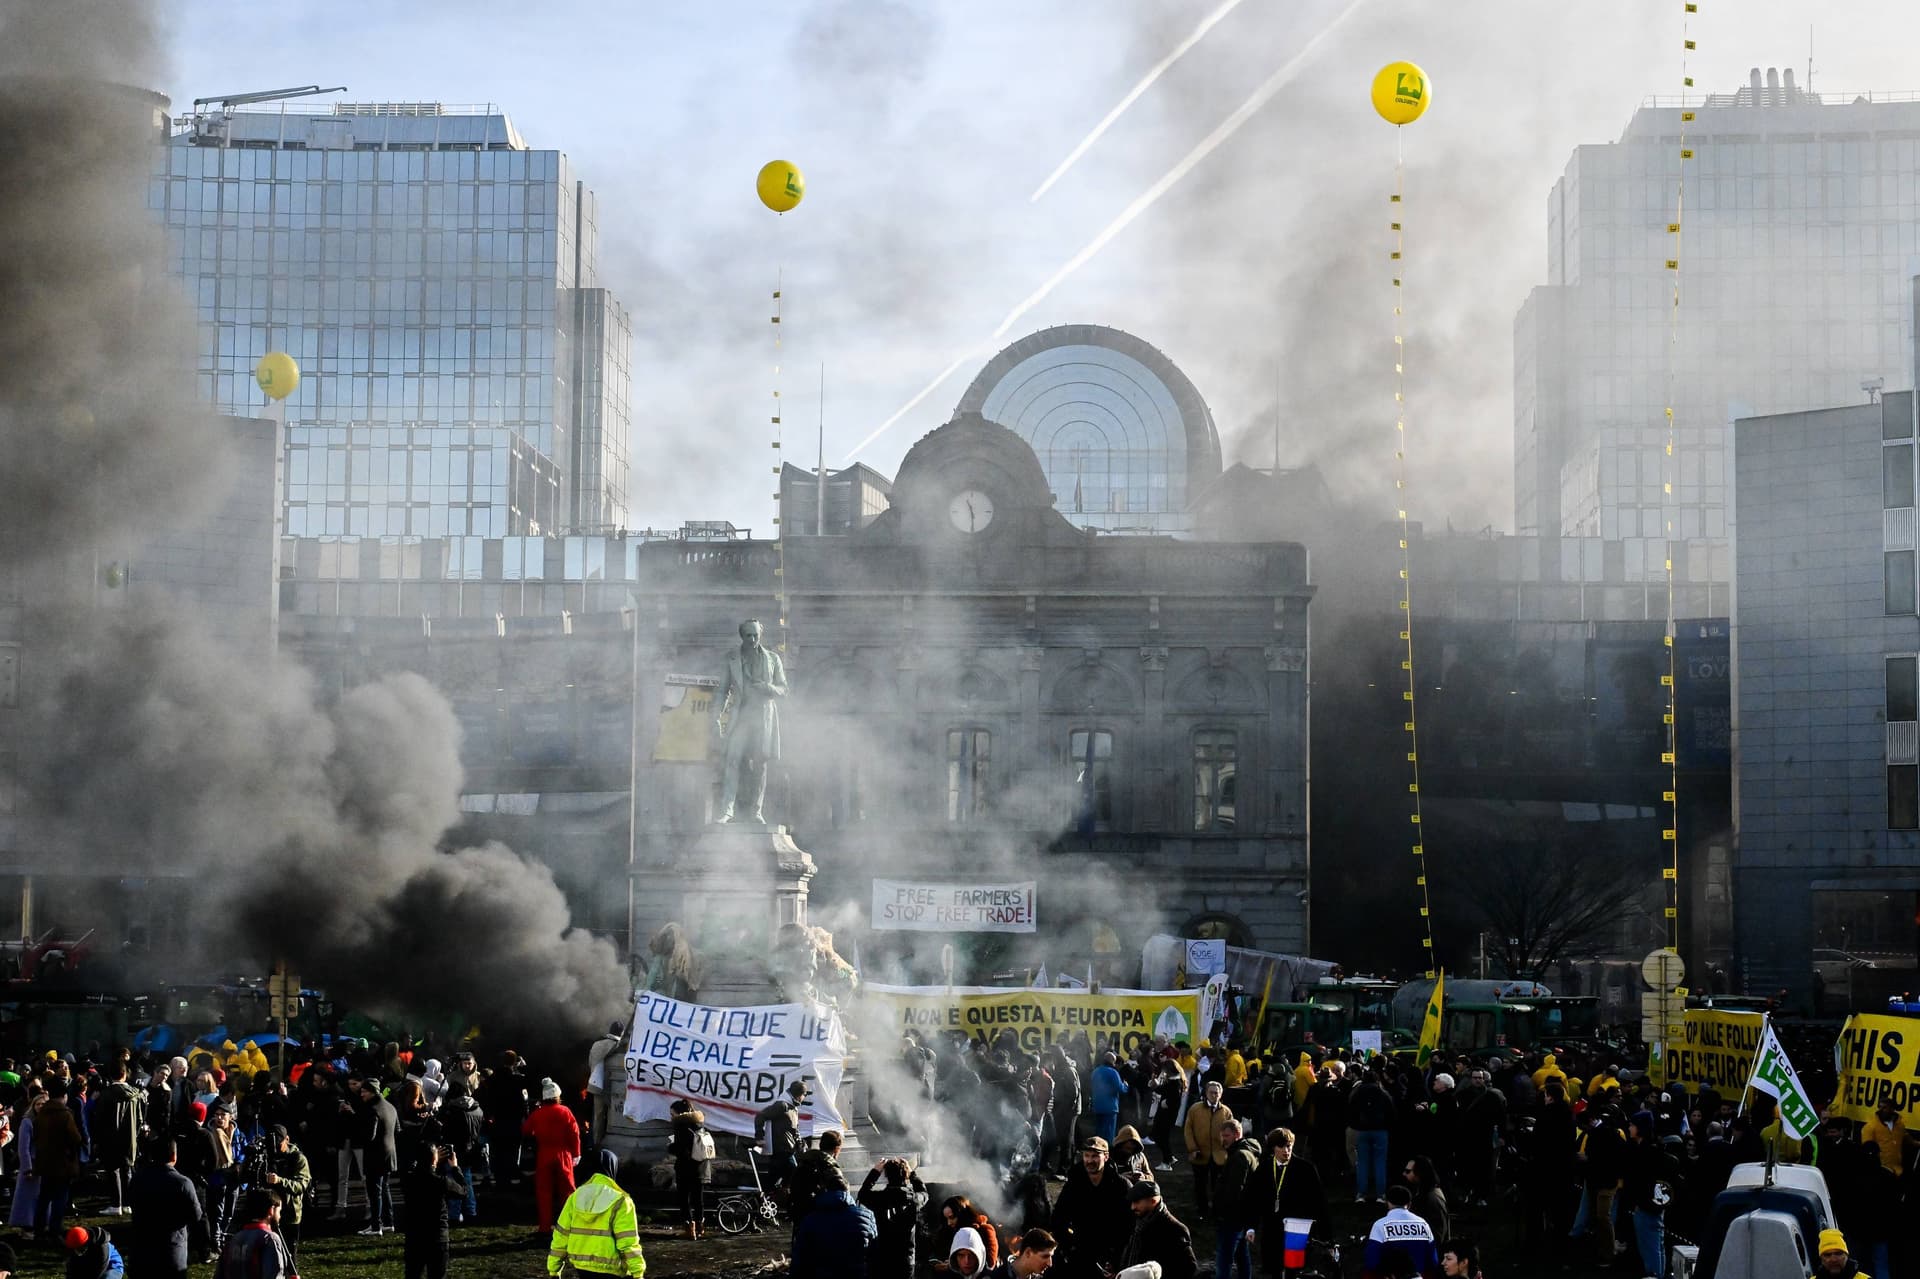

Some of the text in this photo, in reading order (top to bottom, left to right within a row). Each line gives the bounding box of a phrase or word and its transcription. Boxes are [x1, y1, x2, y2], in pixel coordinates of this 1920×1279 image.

[1688, 663, 1730, 678] LOV
[896, 889, 1022, 906] FREE FARMERS
[884, 904, 925, 921] STOP
[936, 907, 972, 922] FREE
[903, 1007, 942, 1025] NON
[966, 1005, 1044, 1025] QUESTA
[1051, 1007, 1145, 1027] L'EUROPA
[629, 1029, 753, 1069] LIBERALE
[1844, 1028, 1903, 1073] THIS
[1385, 1224, 1428, 1237] RUSSIA
